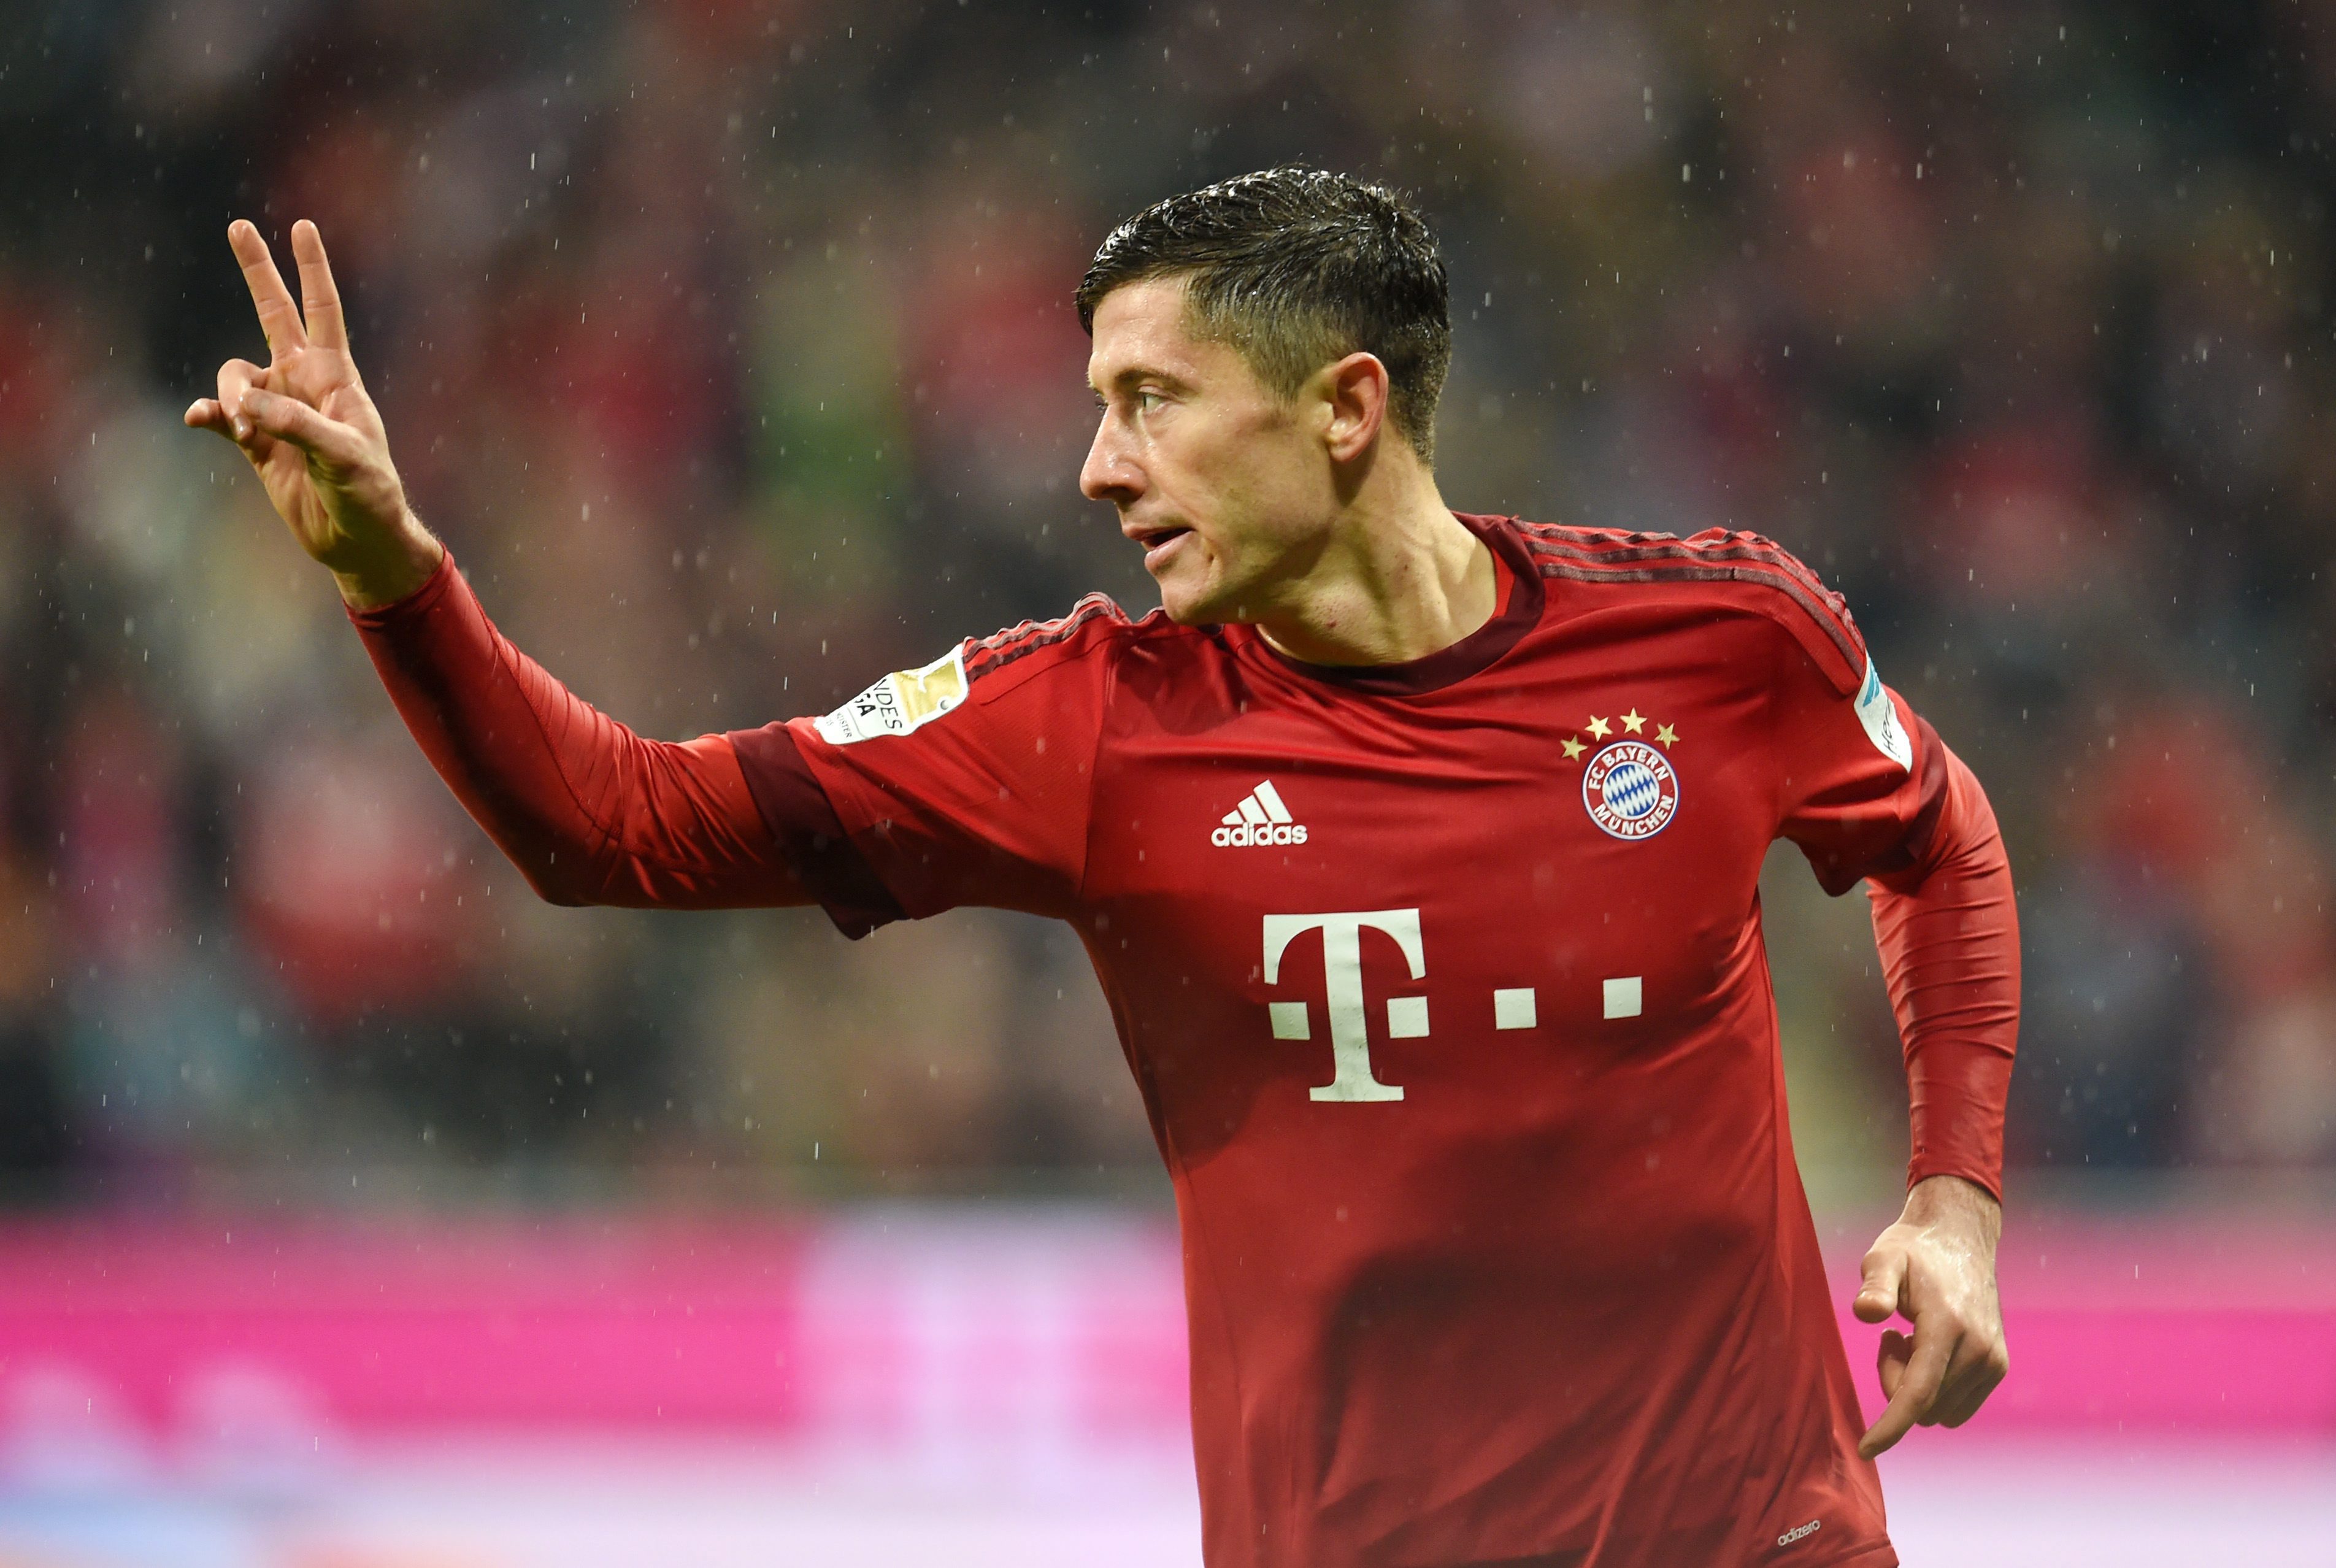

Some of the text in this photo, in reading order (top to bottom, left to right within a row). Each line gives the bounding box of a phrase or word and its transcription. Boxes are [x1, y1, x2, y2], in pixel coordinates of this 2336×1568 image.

[1588, 746, 1669, 790] FC BAYERN
[1210, 821, 1308, 847] adidas
[1594, 794, 1674, 835] MÜNCHEN
[1263, 908, 1426, 1102] T
[1777, 1520, 1821, 1547] adizero
